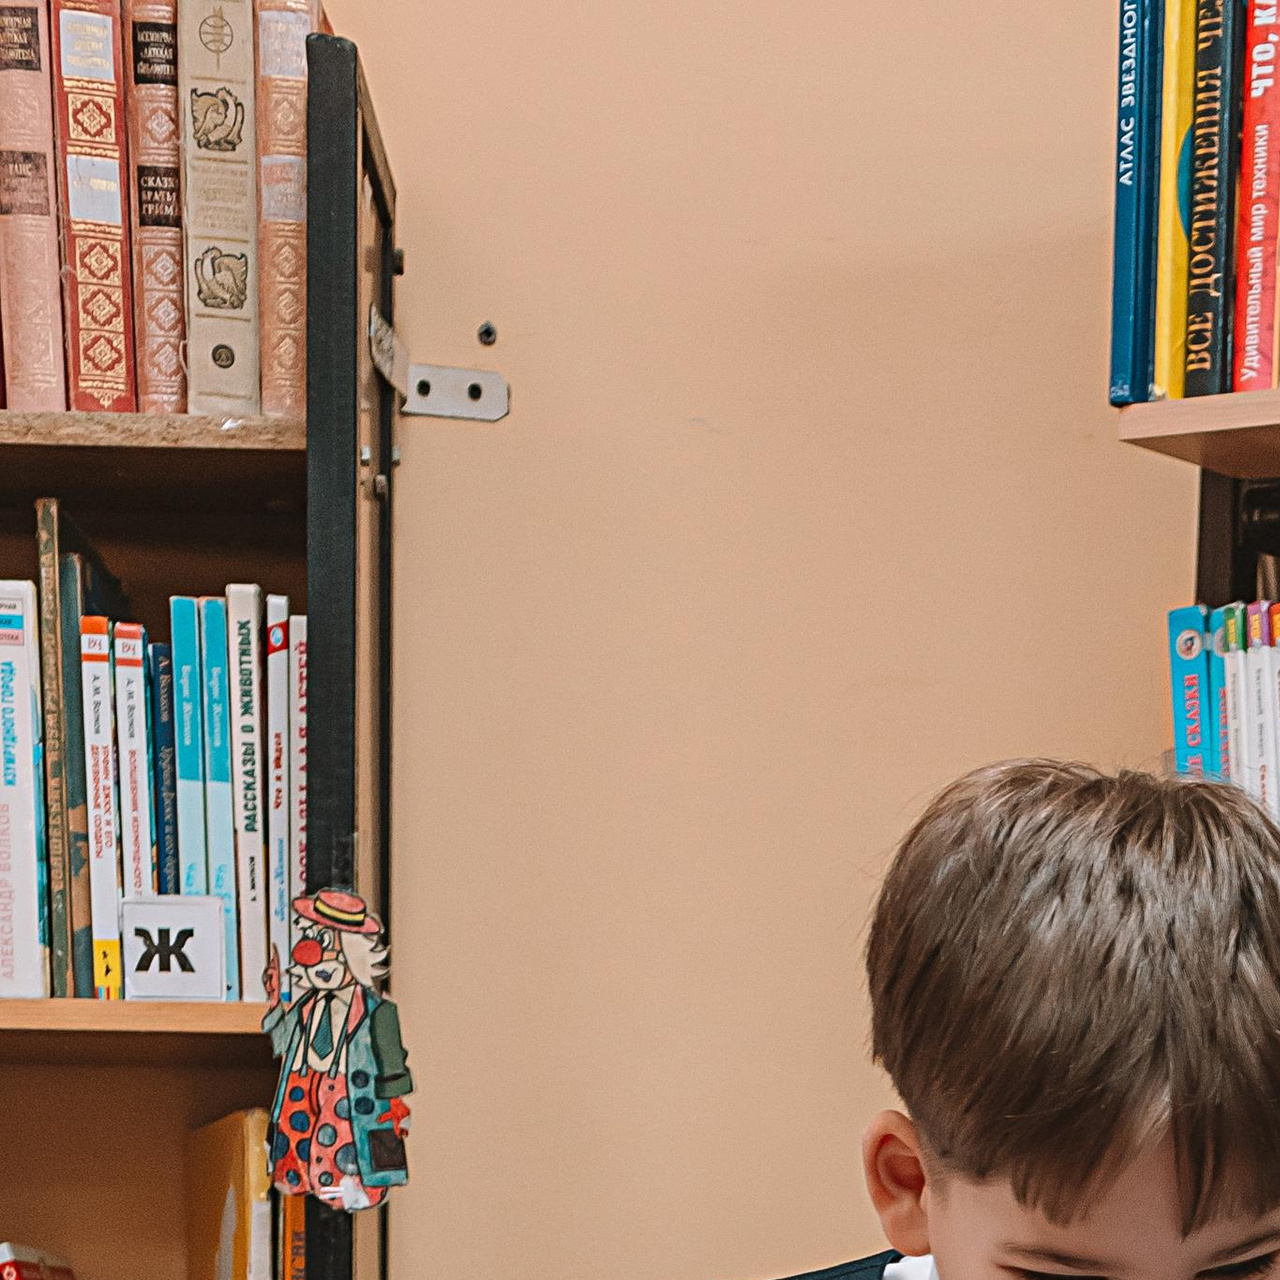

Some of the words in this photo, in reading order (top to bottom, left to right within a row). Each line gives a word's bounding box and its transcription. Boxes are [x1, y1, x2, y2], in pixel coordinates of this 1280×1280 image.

[1251, 32, 1280, 98] ЧТО,
[1119, 117, 1135, 186] АТЛАС
[1189, 66, 1222, 297] ДОСТИЖЕНИЯ
[1251, 124, 1269, 198] техники
[1251, 203, 1268, 242] мир
[1186, 312, 1213, 372] ВСЕ
[1241, 244, 1264, 382] Удивительный
[237, 619, 255, 717] ЖИВОТНЫХ
[240, 724, 255, 734] О
[1184, 674, 1202, 747] СКАЗКИ
[238, 741, 259, 833] РАССКАЗЫ
[133, 927, 196, 974] Ж
